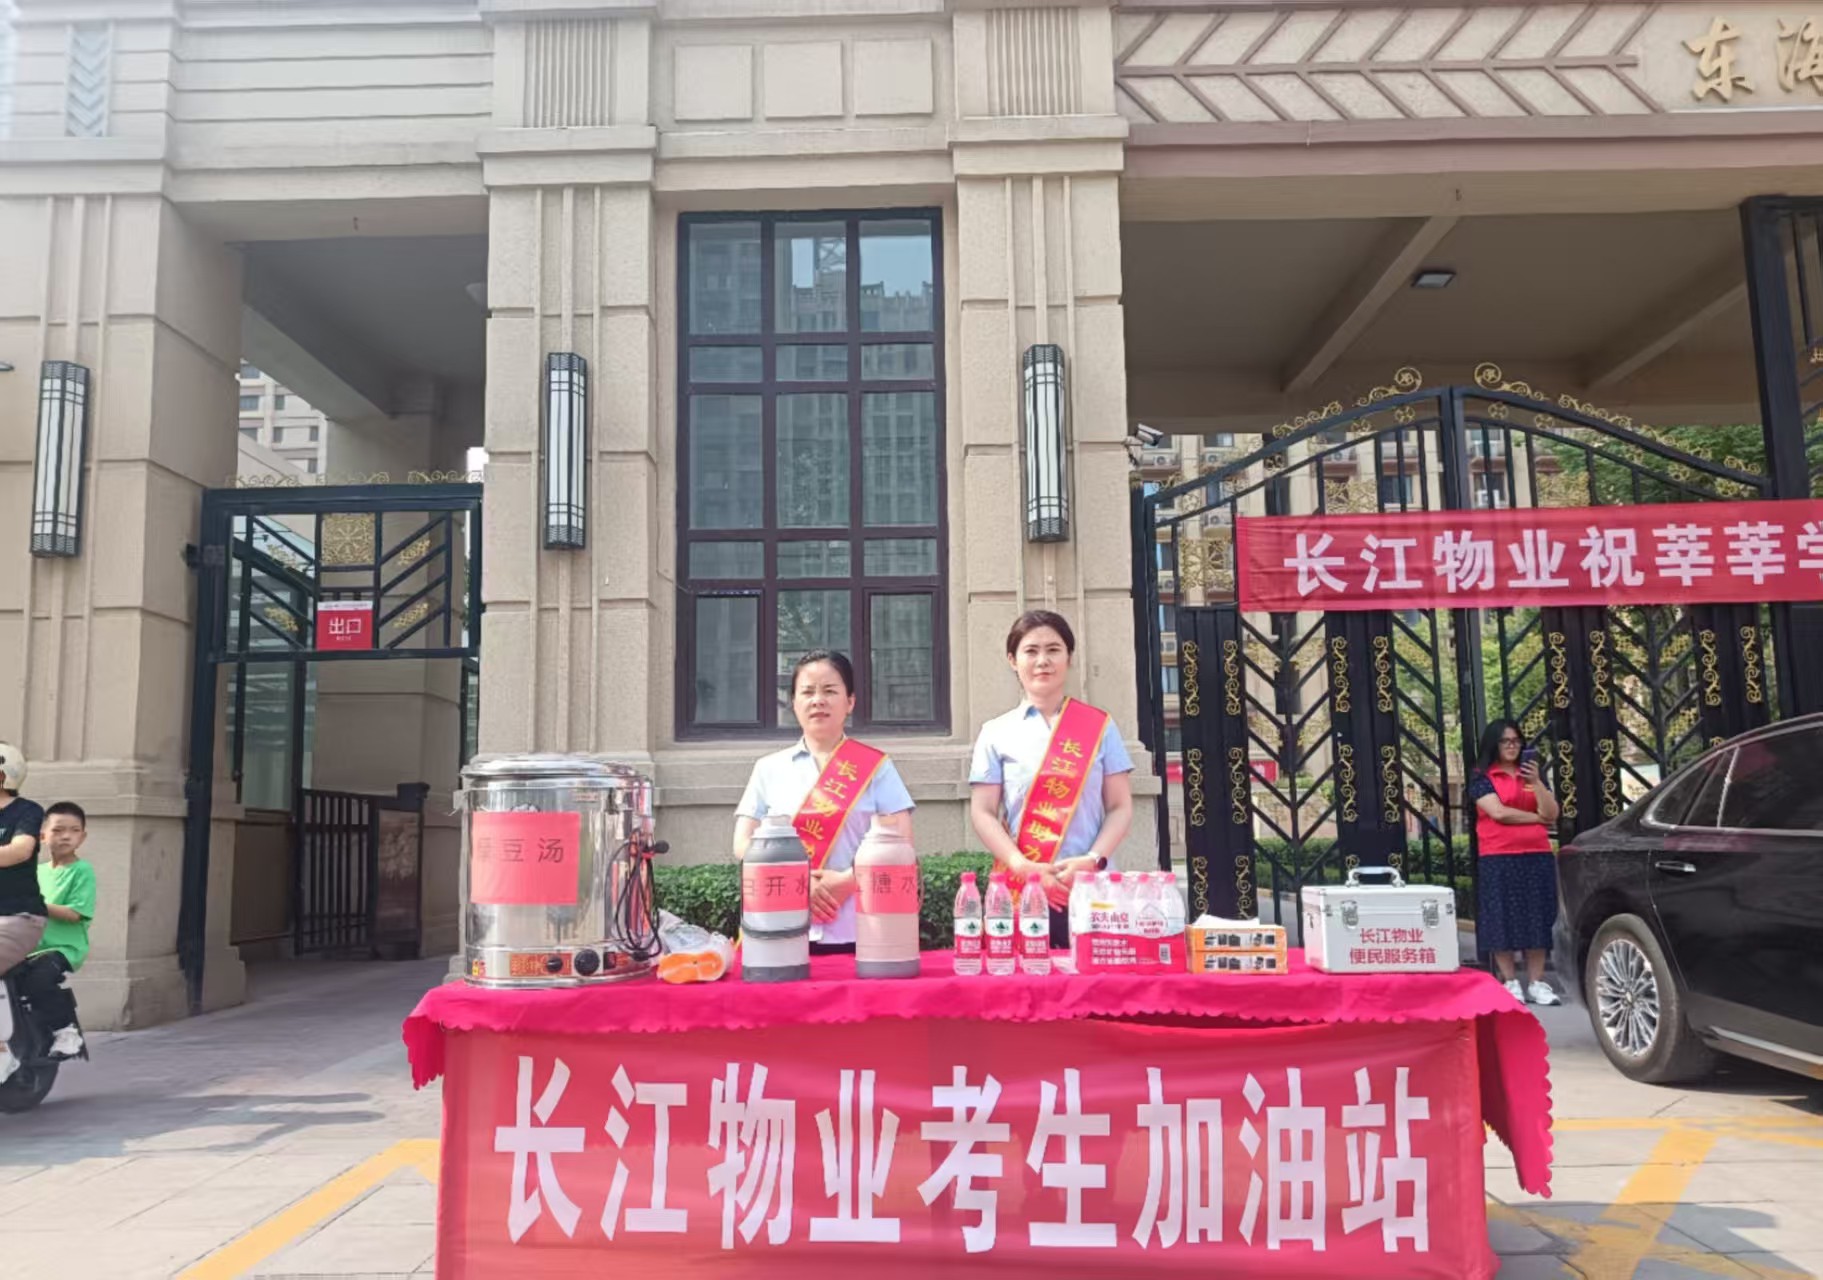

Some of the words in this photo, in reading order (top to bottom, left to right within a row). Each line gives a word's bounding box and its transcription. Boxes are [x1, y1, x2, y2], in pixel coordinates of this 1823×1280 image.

[329, 616, 361, 634] 出口
[1360, 927, 1424, 943] 长江物业
[1349, 947, 1437, 965] 便民服务箱
[494, 1056, 1430, 1255] 长江物业考生加油站
